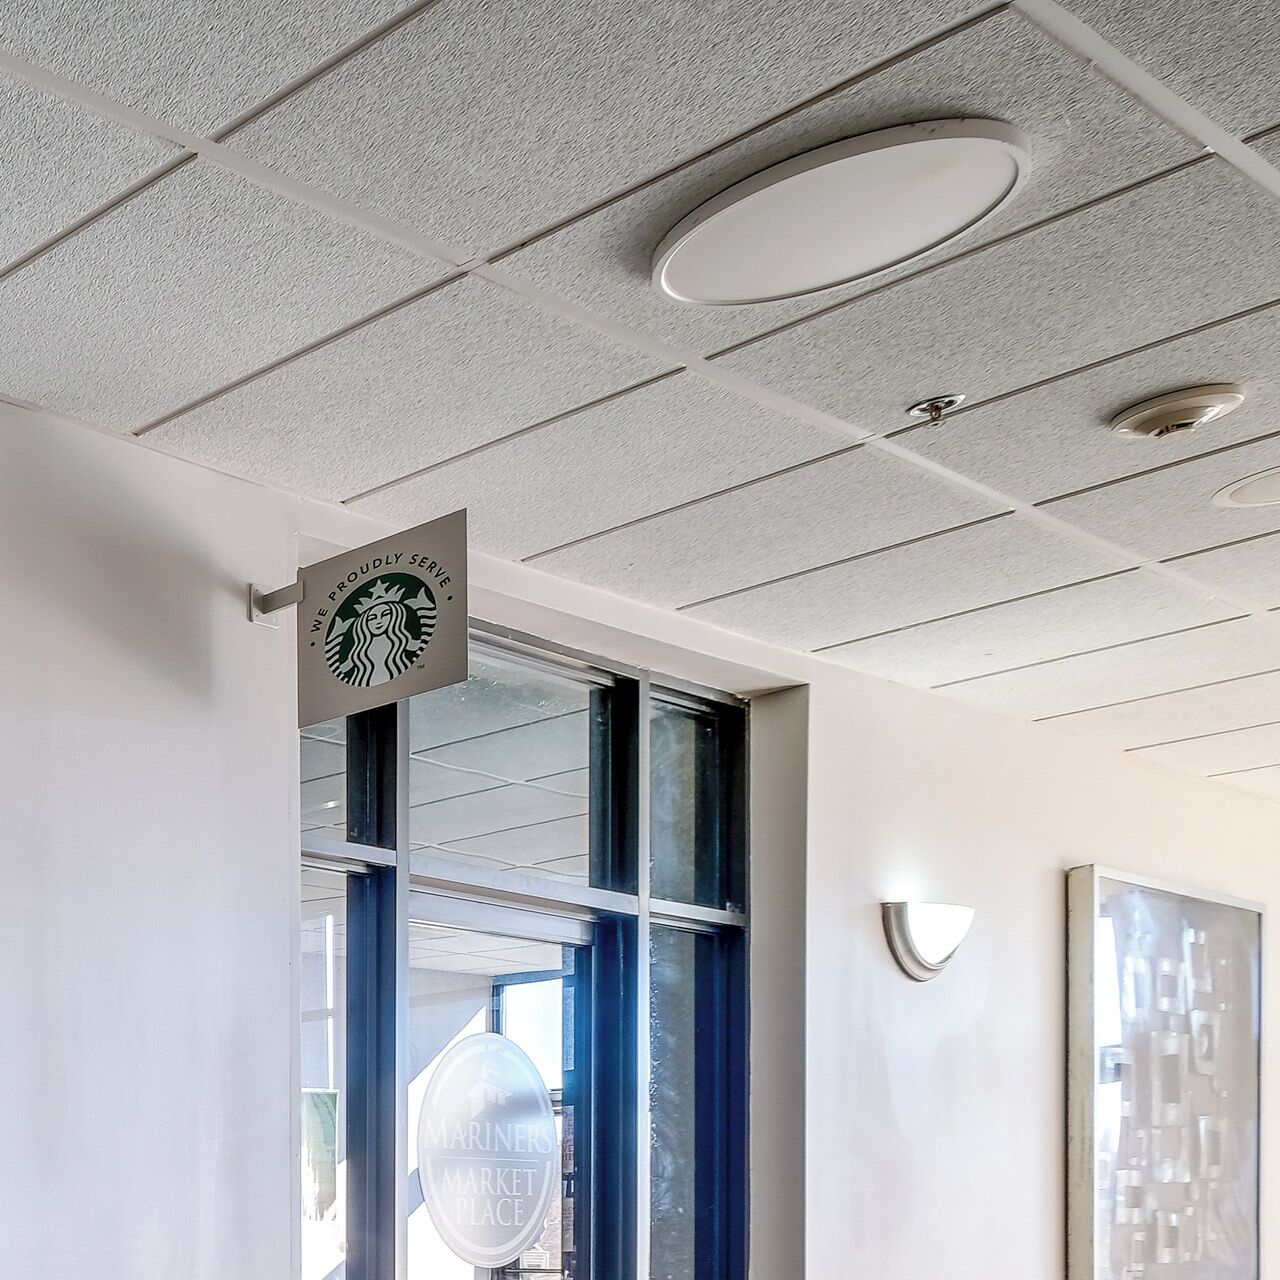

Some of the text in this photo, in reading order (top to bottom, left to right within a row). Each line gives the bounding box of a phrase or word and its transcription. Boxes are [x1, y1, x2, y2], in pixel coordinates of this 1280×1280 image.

[311, 553, 451, 633] WE PROUDLY SERVE
[425, 1120, 553, 1153] MARINERS
[442, 1167, 537, 1196] MARKET
[454, 1198, 523, 1226] PLACE
